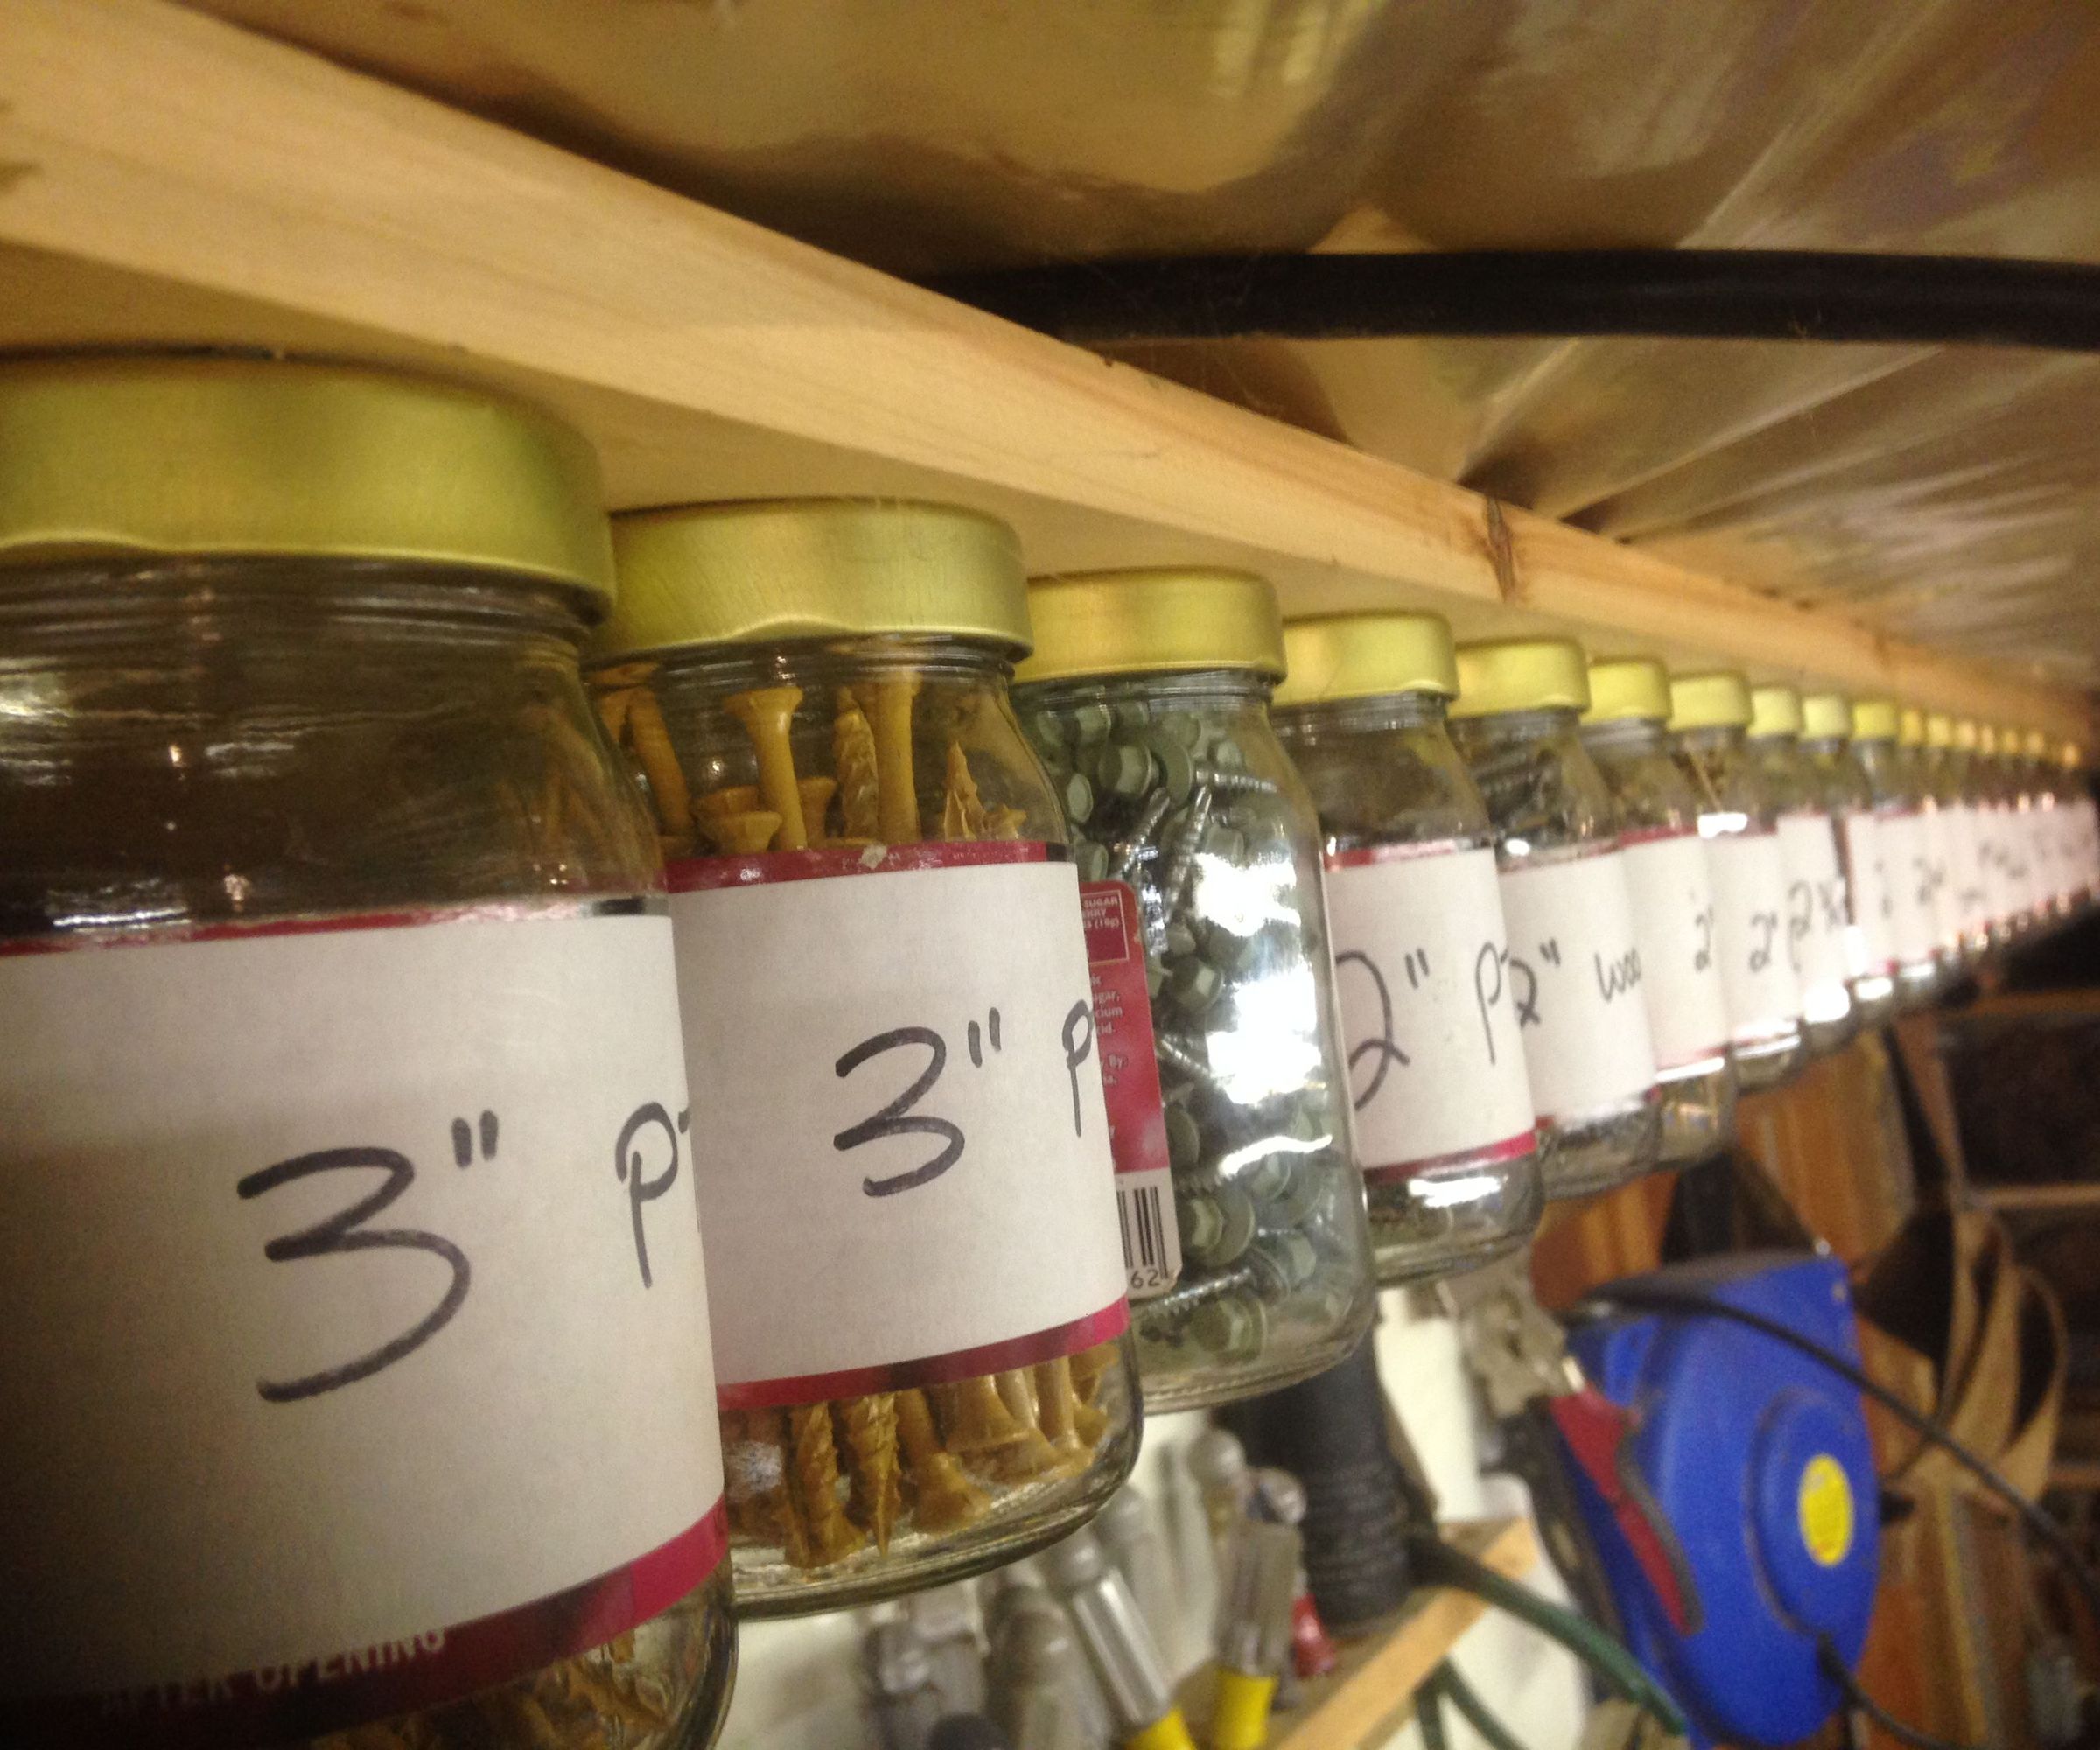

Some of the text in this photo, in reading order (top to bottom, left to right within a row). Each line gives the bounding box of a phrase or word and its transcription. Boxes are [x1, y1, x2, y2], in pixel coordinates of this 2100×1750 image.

[1083, 895, 1118, 908] SUGAR
[1335, 940, 1508, 1111] 2" P
[1508, 937, 1562, 1029] 2"
[833, 1007, 1001, 1199] 3"
[237, 1101, 690, 1400] 3" P
[1130, 1268, 1161, 1290] 62
